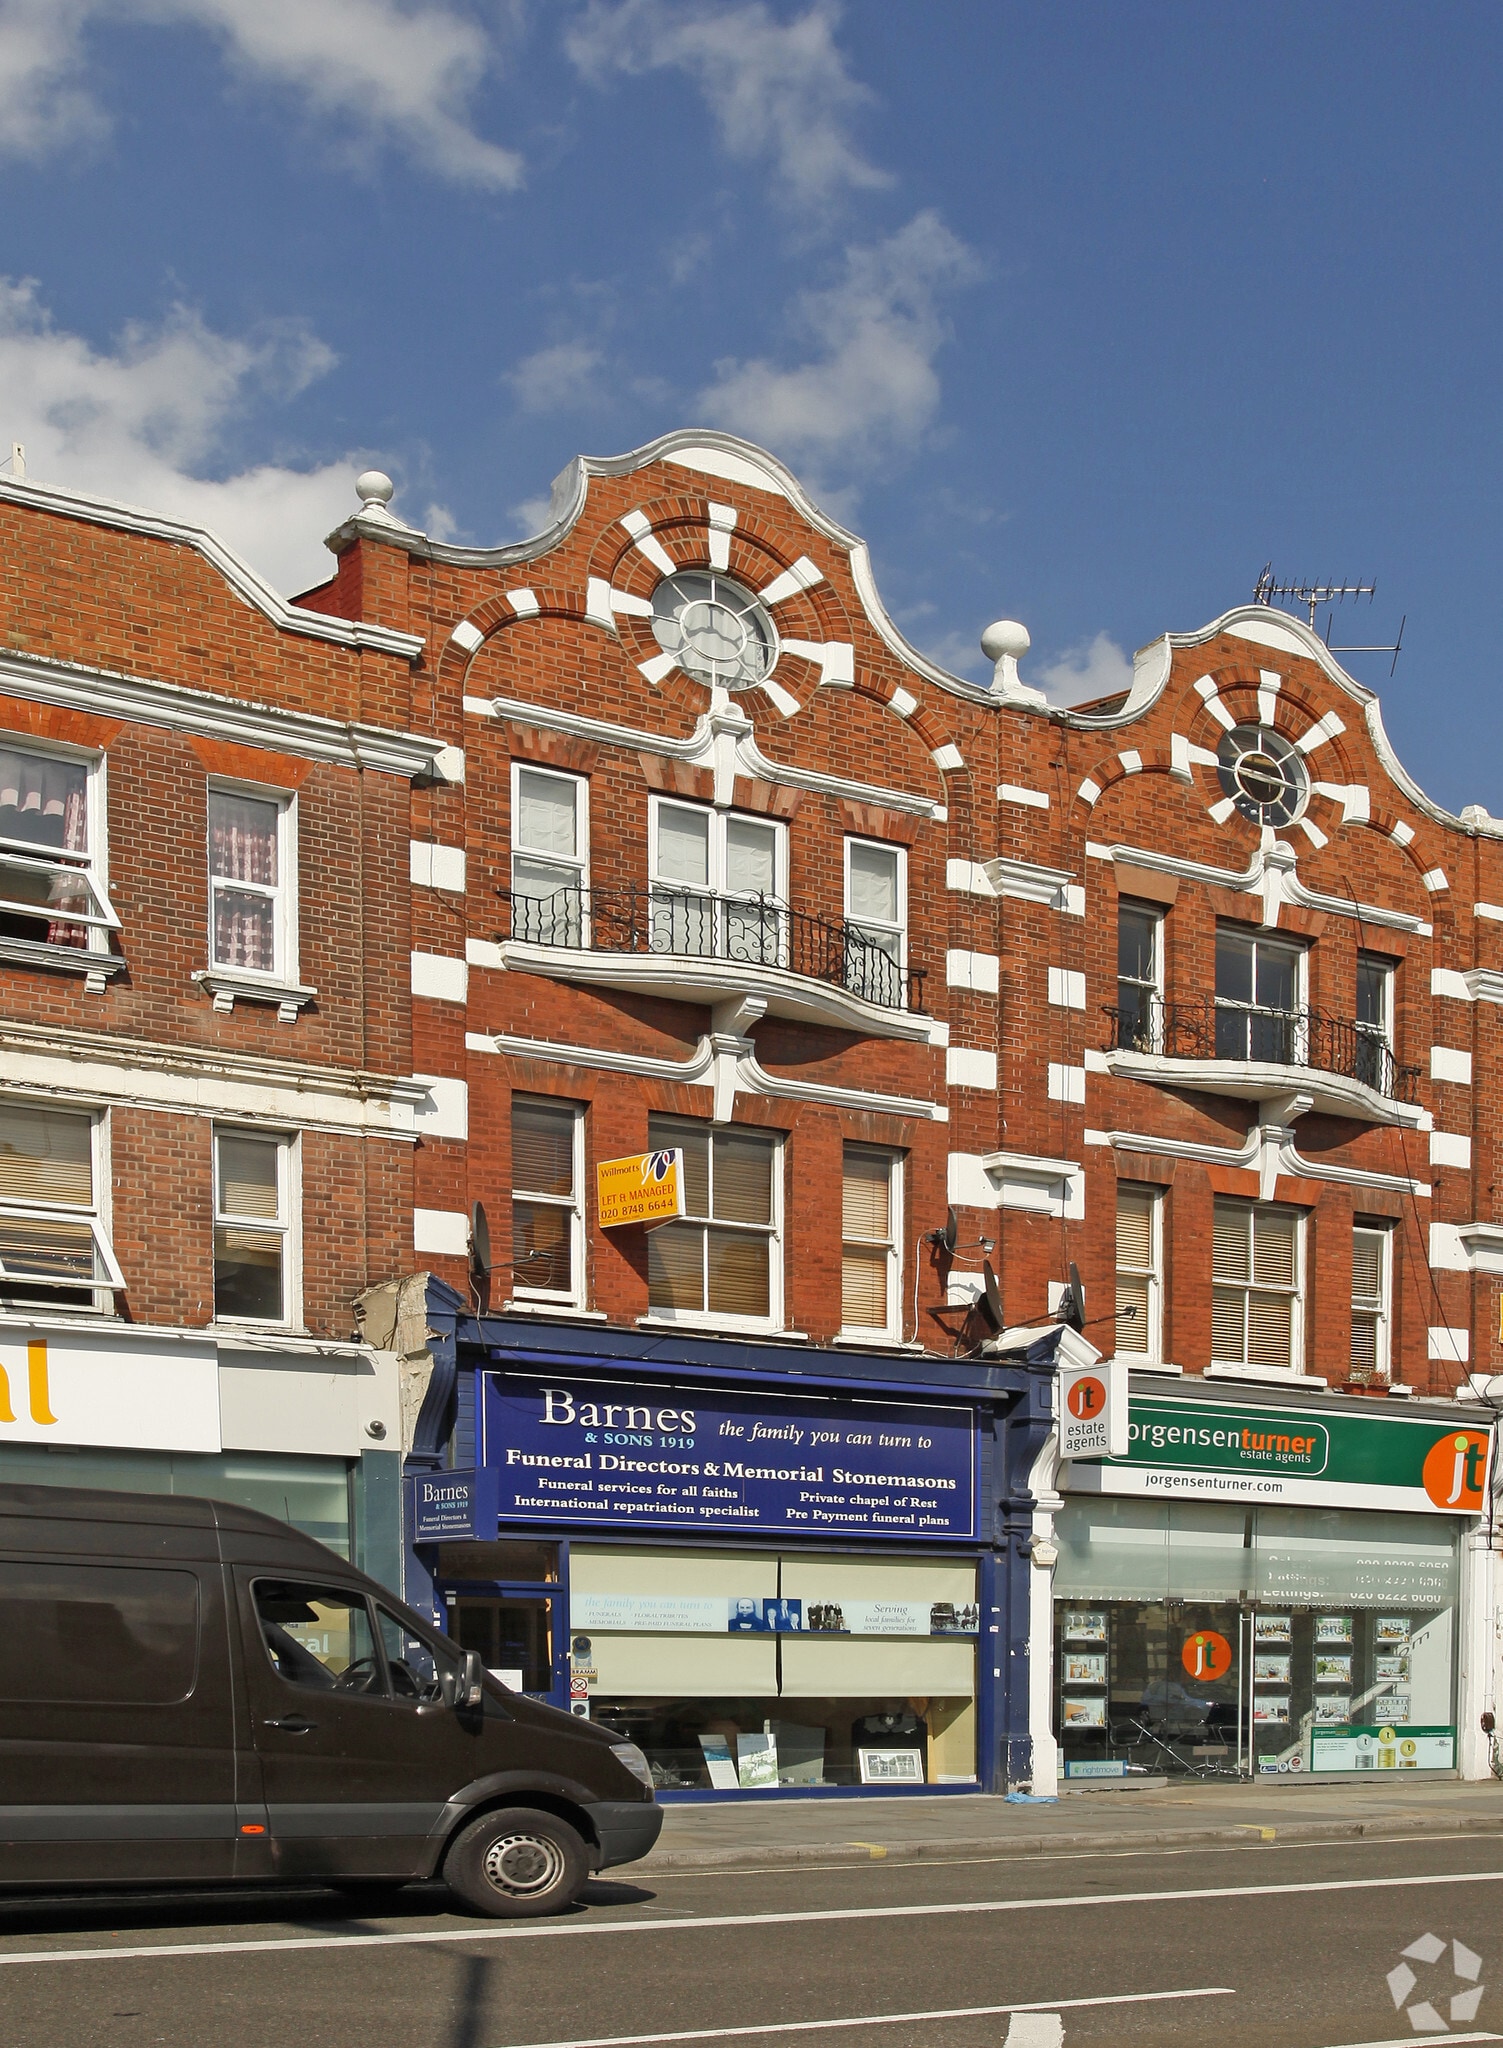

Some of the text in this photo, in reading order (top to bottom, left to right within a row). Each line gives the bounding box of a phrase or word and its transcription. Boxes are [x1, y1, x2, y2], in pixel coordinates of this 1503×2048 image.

[601, 1164, 640, 1178] Willmotts
[601, 1184, 674, 1207] LET & MANAGED
[601, 1198, 674, 1220] 020 8748 6644
[1077, 1383, 1095, 1416] jt
[538, 1388, 697, 1434] Barnes
[718, 1420, 932, 1449] the family you can turn to
[1067, 1422, 1105, 1436] estate
[584, 1432, 695, 1449] & SONS 1919
[1066, 1435, 1107, 1451] agents
[1127, 1423, 1317, 1454] orgensenturner
[1240, 1449, 1311, 1464] estate agents
[506, 1449, 957, 1490] Funeral Directors & Memorial Stonemasons
[1446, 1435, 1486, 1505] jt
[538, 1478, 738, 1499] Funeral services for all faiths
[1145, 1471, 1283, 1493] jorgensenturner.com
[423, 1483, 469, 1502] Barnes
[799, 1491, 937, 1509] Private chapel of Rest
[441, 1501, 456, 1510] SONS
[514, 1495, 760, 1518] International repatriation specialist
[419, 1522, 472, 1531] Memorial Stonemasons
[422, 1514, 440, 1522] Funeral
[440, 1513, 462, 1521] Directors
[786, 1508, 950, 1527] Pre Payment funeral plans
[585, 1597, 713, 1610] the family you can turn to
[873, 1604, 909, 1615] Serving
[864, 1615, 916, 1626] local families for
[881, 1625, 917, 1633] generations
[1194, 1635, 1216, 1677] jt
[1082, 1766, 1119, 1775] rightmove
